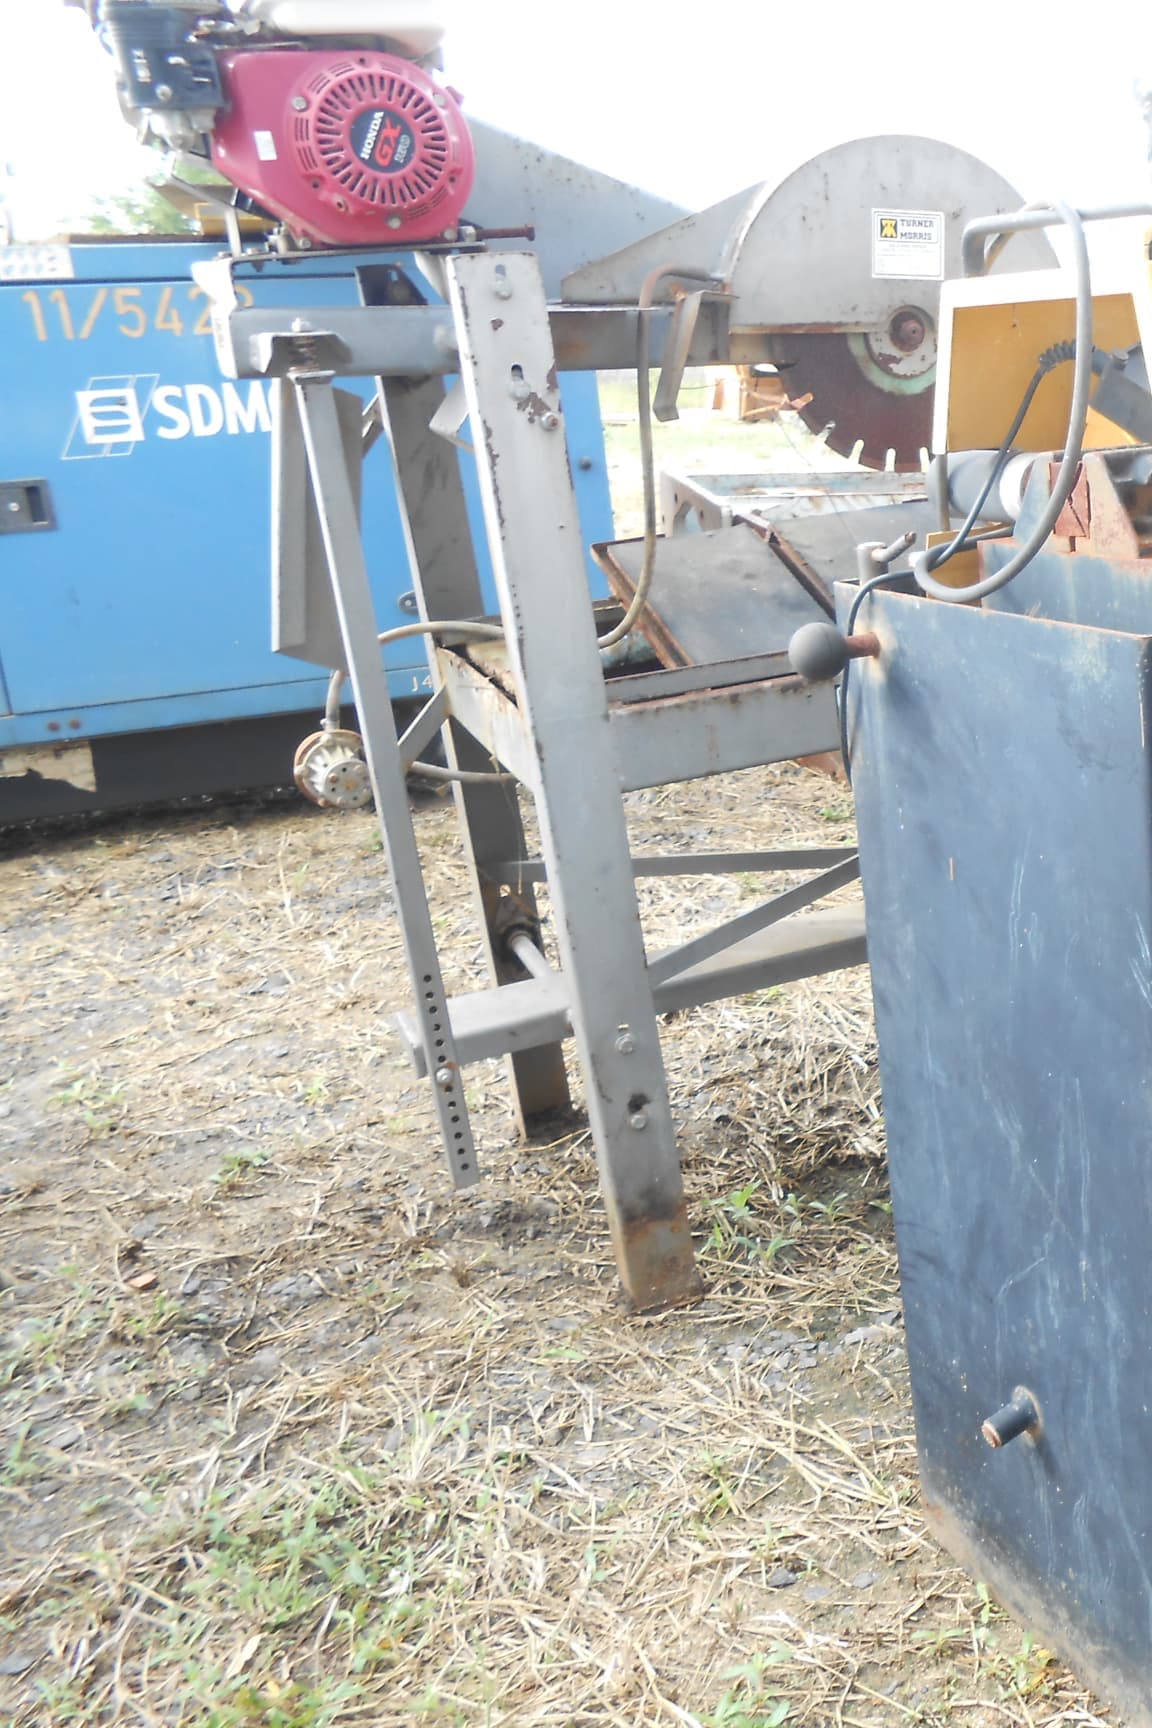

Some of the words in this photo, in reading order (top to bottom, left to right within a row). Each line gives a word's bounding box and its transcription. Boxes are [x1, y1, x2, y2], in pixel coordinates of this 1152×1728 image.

[360, 112, 384, 160] HONDA
[375, 117, 402, 166] GX
[900, 219, 934, 228] TURNER
[900, 232, 932, 240] MORRIS
[151, 380, 273, 440] SDM
